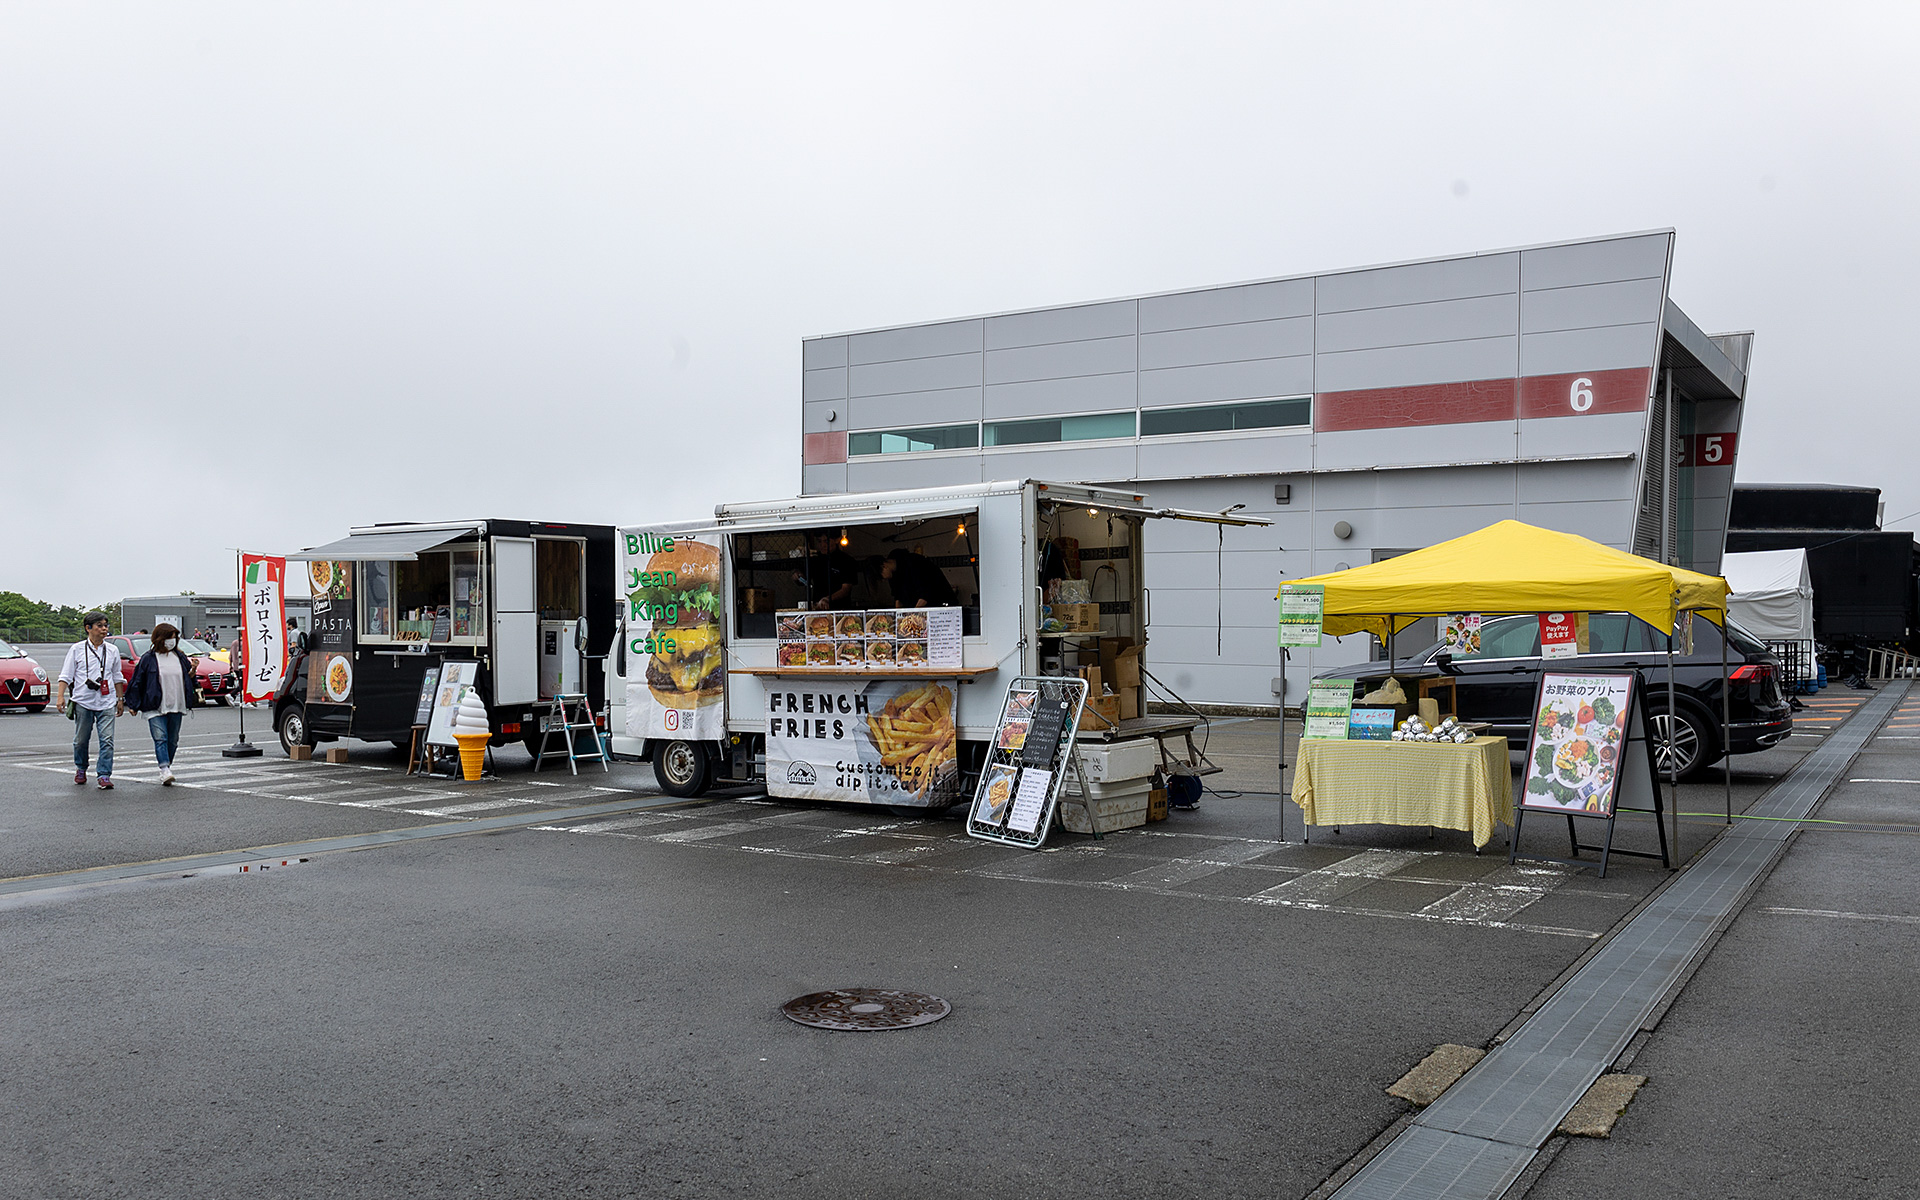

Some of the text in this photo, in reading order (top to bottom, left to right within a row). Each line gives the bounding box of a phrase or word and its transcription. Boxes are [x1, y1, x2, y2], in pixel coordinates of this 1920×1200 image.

[1570, 377, 1593, 412] 6
[1704, 436, 1723, 462] 5
[626, 532, 675, 555] Billie
[628, 567, 677, 588] Jean
[630, 600, 678, 625] King
[254, 585, 277, 682] ボロネーゼ
[314, 618, 352, 631] PASTA
[1546, 631, 1570, 639] 使えます
[630, 632, 677, 654] cafe
[1545, 684, 1626, 697] お野菜のブリトー
[770, 693, 869, 714] FRENCH
[770, 718, 844, 740] FRIES
[835, 760, 922, 777] Customize
